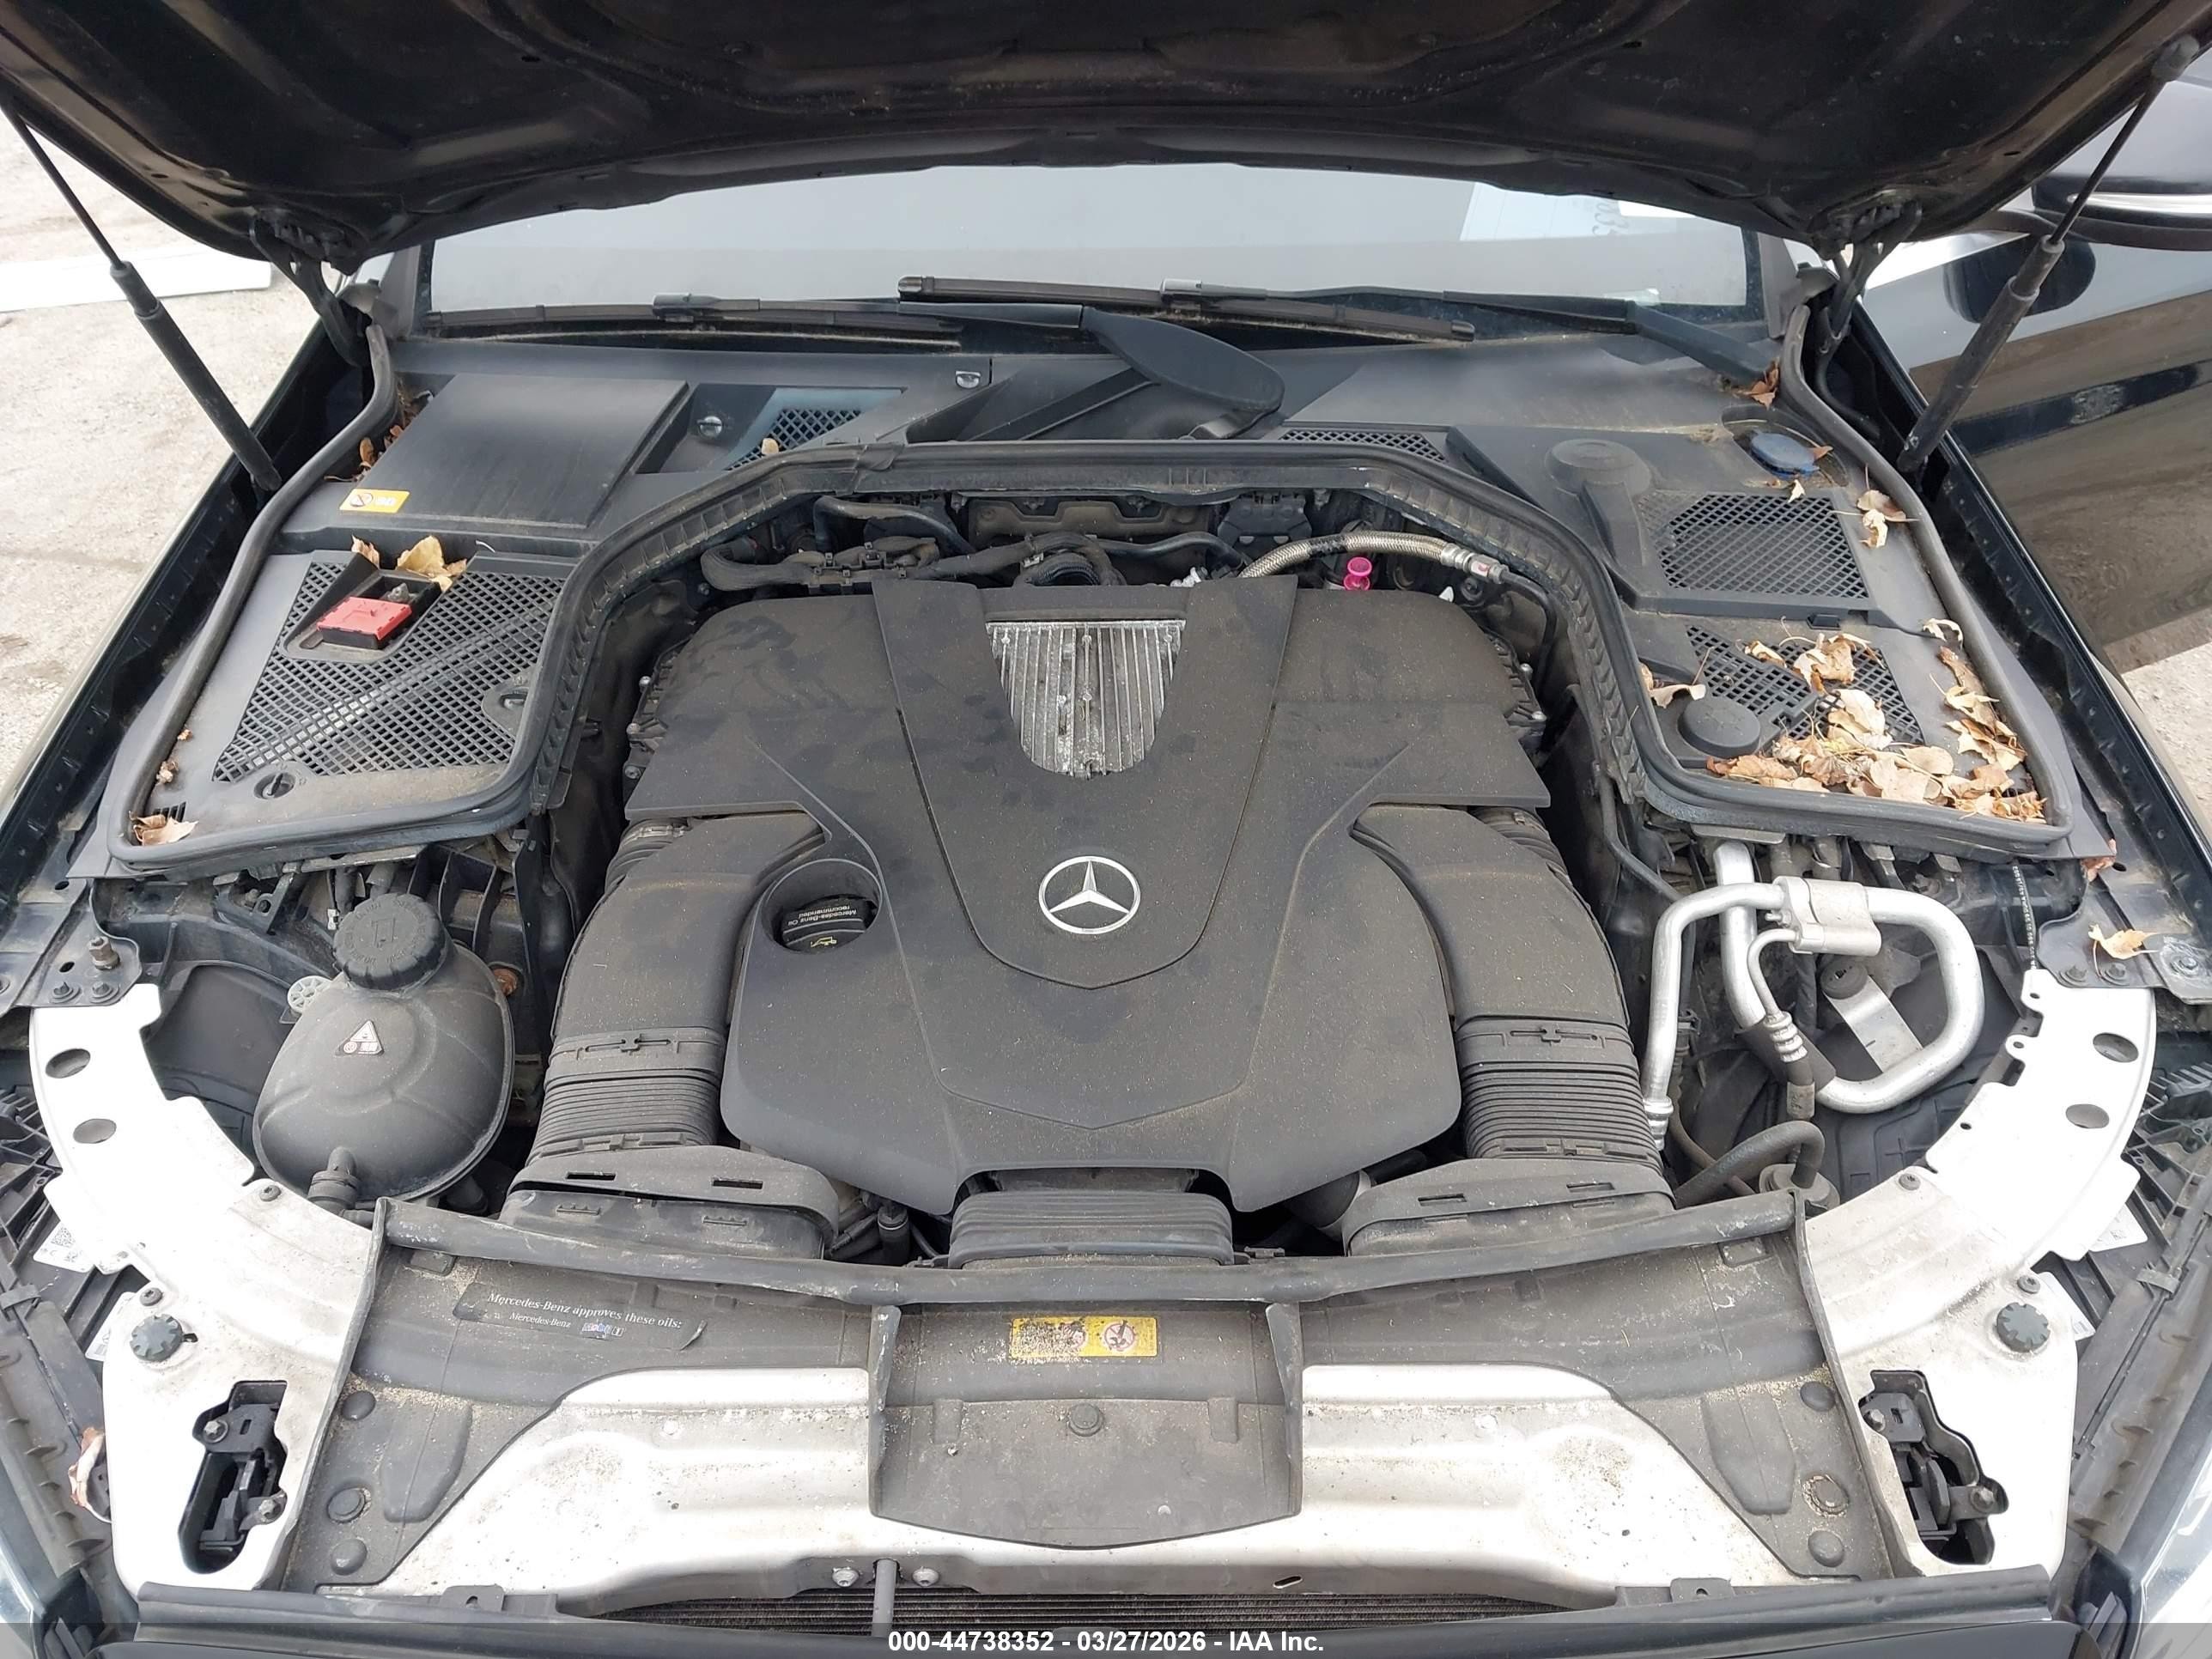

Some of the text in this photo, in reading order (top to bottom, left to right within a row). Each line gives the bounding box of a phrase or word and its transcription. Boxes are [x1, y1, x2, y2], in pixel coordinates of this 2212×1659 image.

[800, 909, 857, 923] Mercedes-Benz
[488, 1293, 571, 1313] Mercedes-Benz
[572, 1306, 623, 1320] approves
[624, 1312, 655, 1326] these
[658, 1317, 683, 1329] oils:
[509, 1311, 571, 1328] Mercedes-Benz
